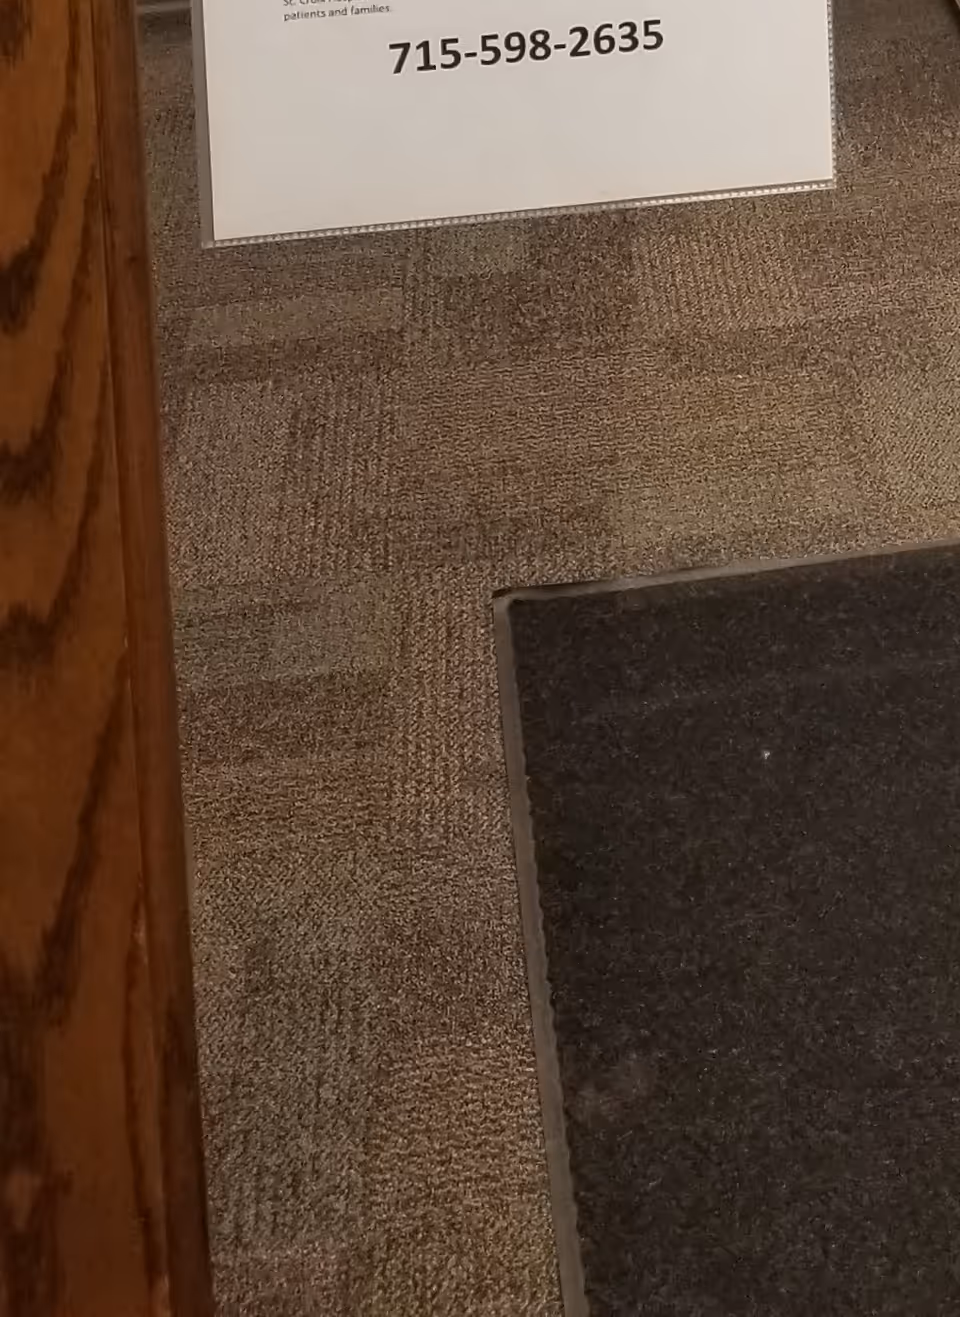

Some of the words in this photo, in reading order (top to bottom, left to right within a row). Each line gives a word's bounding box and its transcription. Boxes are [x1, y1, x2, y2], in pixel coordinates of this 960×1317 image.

[284, 10, 326, 22] patients
[328, 8, 347, 16] and
[389, 20, 663, 74] 715-598-2635
